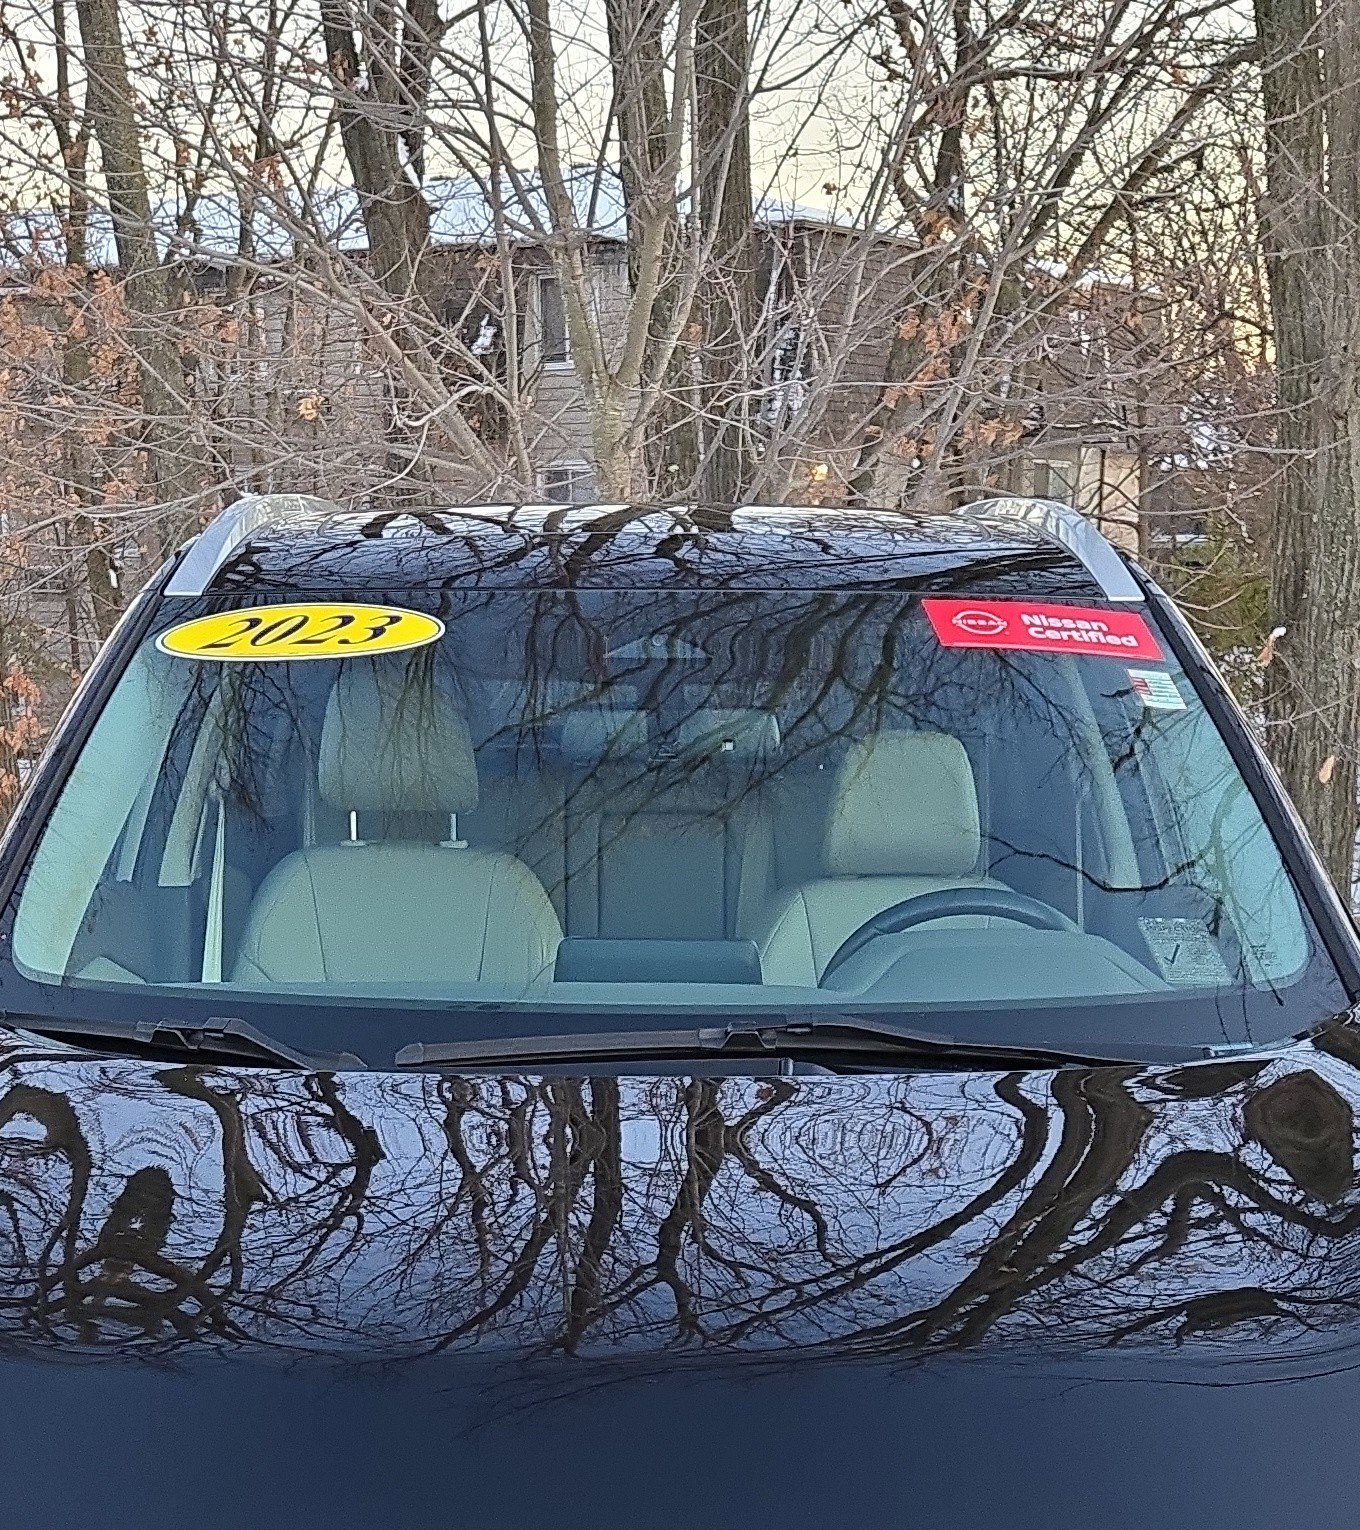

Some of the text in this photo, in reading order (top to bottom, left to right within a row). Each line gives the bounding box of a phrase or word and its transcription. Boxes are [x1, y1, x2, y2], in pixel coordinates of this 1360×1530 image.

[196, 614, 403, 650] 2023
[952, 617, 1007, 628] NISSAN
[1021, 613, 1108, 632] Nissan
[1028, 627, 1139, 647] Certified
